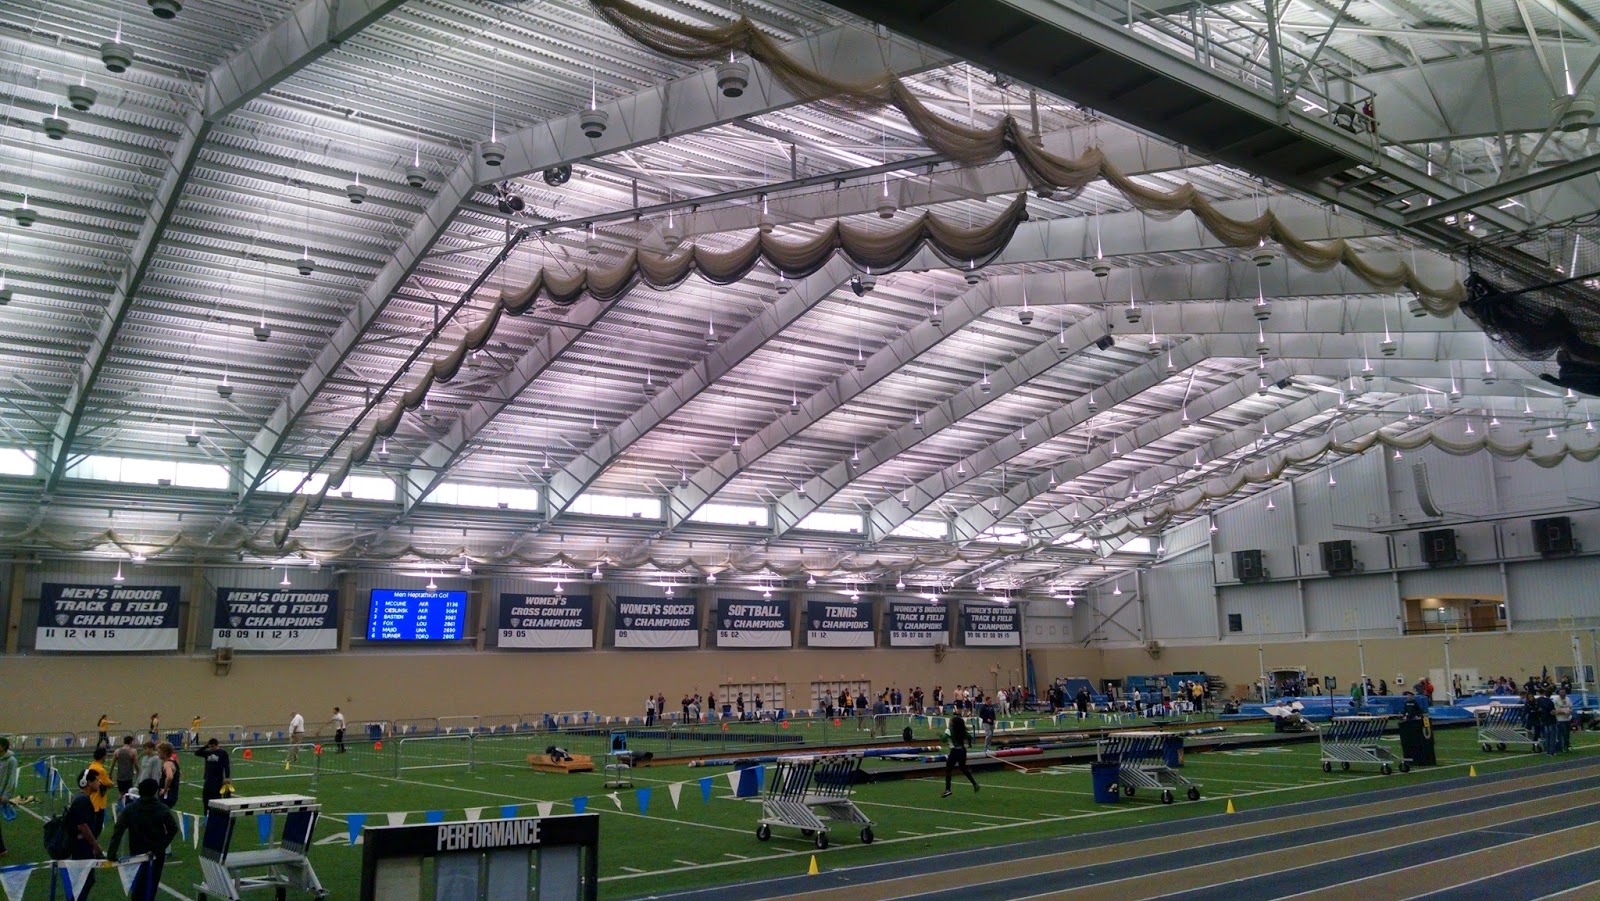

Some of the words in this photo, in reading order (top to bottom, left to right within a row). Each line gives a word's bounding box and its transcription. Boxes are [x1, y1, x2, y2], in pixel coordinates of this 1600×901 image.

[61, 588, 109, 599] MEN'S
[110, 589, 162, 600] INDOOR
[227, 592, 269, 602] MEN'S
[271, 593, 329, 603] OUTDOOR
[55, 600, 107, 611] TRACK
[110, 602, 121, 612] &
[125, 602, 168, 612] FIELD
[525, 597, 567, 605] WOMEN'S
[229, 603, 274, 614] TRACK
[278, 604, 288, 614] &
[291, 604, 328, 614] FIELD
[511, 607, 540, 616] CROSS
[541, 608, 582, 616] COUNTRY
[620, 604, 661, 615] WOMEN'S
[662, 604, 695, 615] SOCCER
[728, 604, 781, 616] SOFTBALL
[825, 606, 857, 618] TENNIS
[894, 605, 923, 613] WOMEN'S
[73, 614, 164, 626] CHAMPIONS
[245, 616, 324, 627] CHAMPIONS
[522, 619, 583, 627] CHAMPIONS
[634, 618, 690, 627] CHAMPIONS
[734, 620, 784, 628] CHAMPIONS
[822, 620, 869, 629] CHAMPIONS
[904, 622, 943, 630] CHAMPIONS
[46, 629, 55, 637] 11
[65, 629, 76, 638] 12
[84, 629, 96, 638] 14
[104, 630, 115, 638] 15
[219, 630, 231, 638] 08
[237, 630, 249, 638] 09
[289, 630, 298, 638] 13
[437, 819, 541, 851] PERFORMANCE
